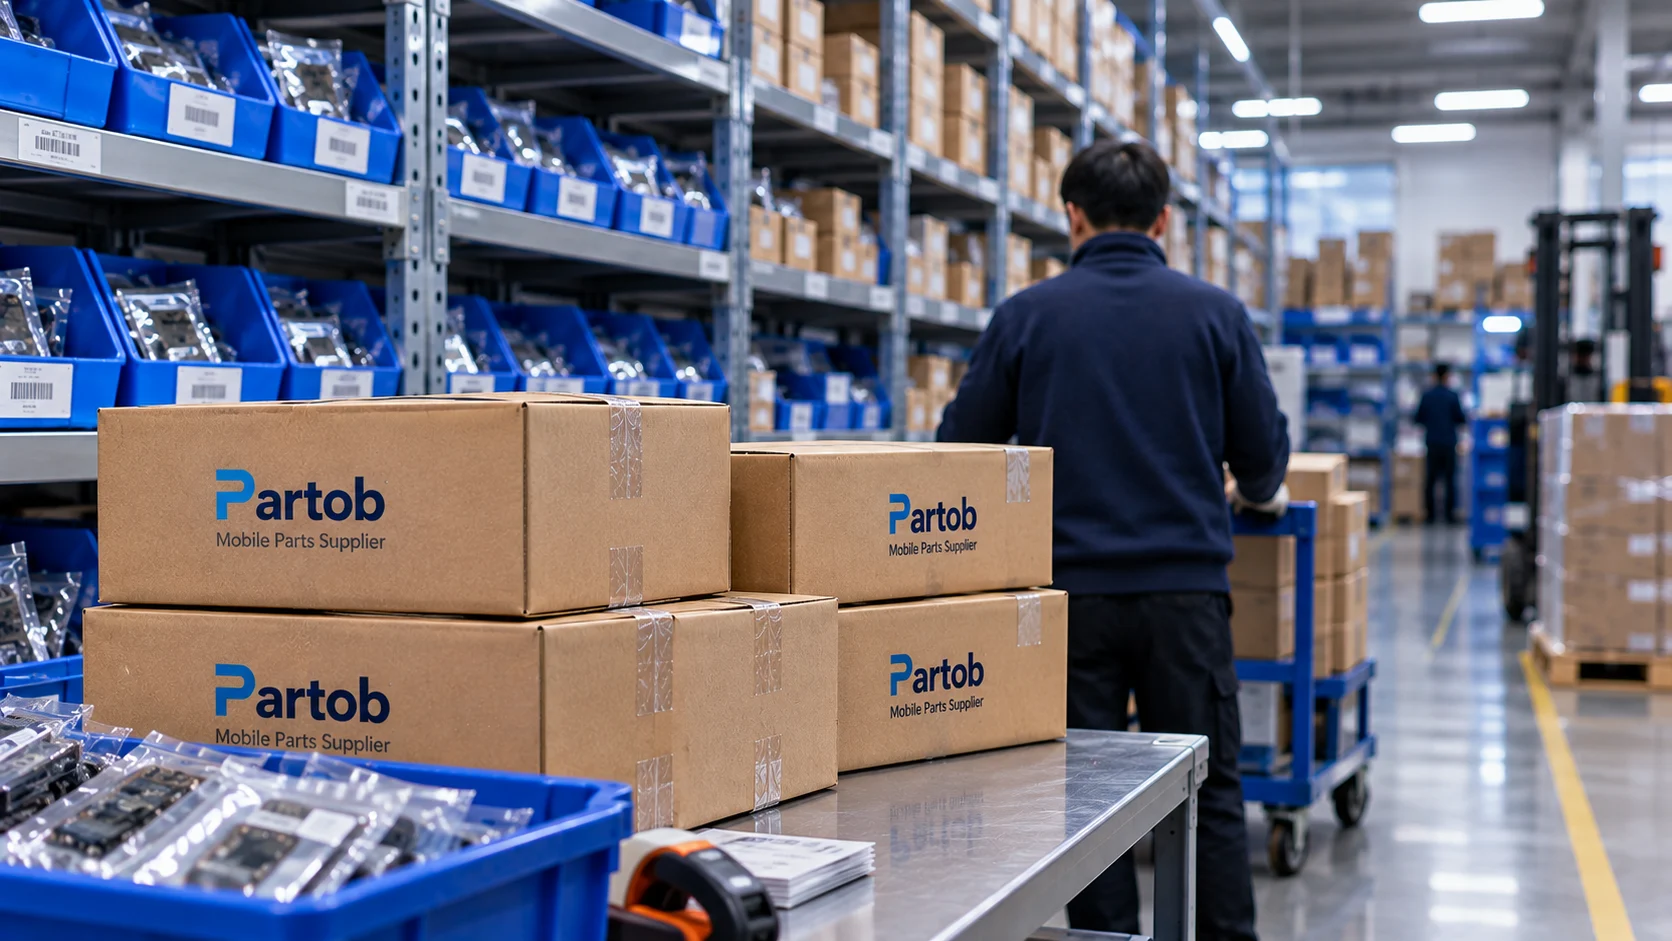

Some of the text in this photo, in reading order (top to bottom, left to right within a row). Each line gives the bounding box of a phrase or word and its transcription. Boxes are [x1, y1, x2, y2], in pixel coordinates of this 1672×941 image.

[216, 469, 385, 521] Partob
[889, 493, 978, 535] Partob
[216, 531, 386, 553] Mobile Parts Supplier
[889, 539, 978, 557] Mobile Parts Supplier
[890, 652, 985, 697] Partob
[215, 663, 390, 724] Partob
[890, 696, 985, 720] Mobile Parts Supplier
[215, 728, 391, 756] Mobile Parts Supplier
